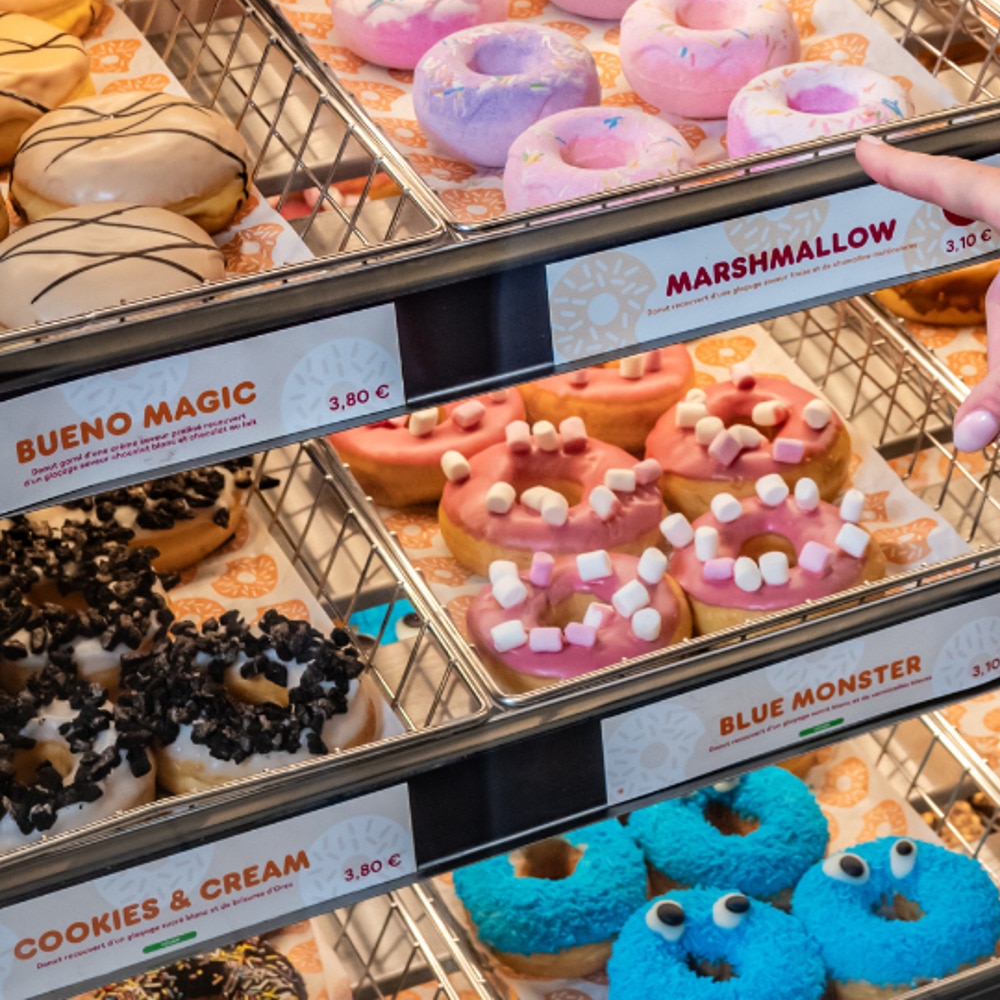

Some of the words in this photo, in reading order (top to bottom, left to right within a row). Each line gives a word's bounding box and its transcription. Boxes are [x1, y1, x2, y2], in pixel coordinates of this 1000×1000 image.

[666, 219, 897, 297] MARSHMALLOW
[946, 233, 976, 253] 3,10
[981, 229, 991, 242] €
[15, 411, 132, 464] BUENO
[143, 381, 257, 429] MAGIC
[329, 390, 370, 411] 3,80
[375, 384, 390, 399] €
[972, 658, 1000, 678] 3,10
[719, 698, 784, 737] BLUE
[793, 654, 921, 710] MONSTER
[344, 860, 382, 881] 3,80
[388, 853, 401, 867] €
[14, 897, 160, 961] COOKIES
[170, 889, 192, 912] &
[200, 849, 310, 901] CREAM
